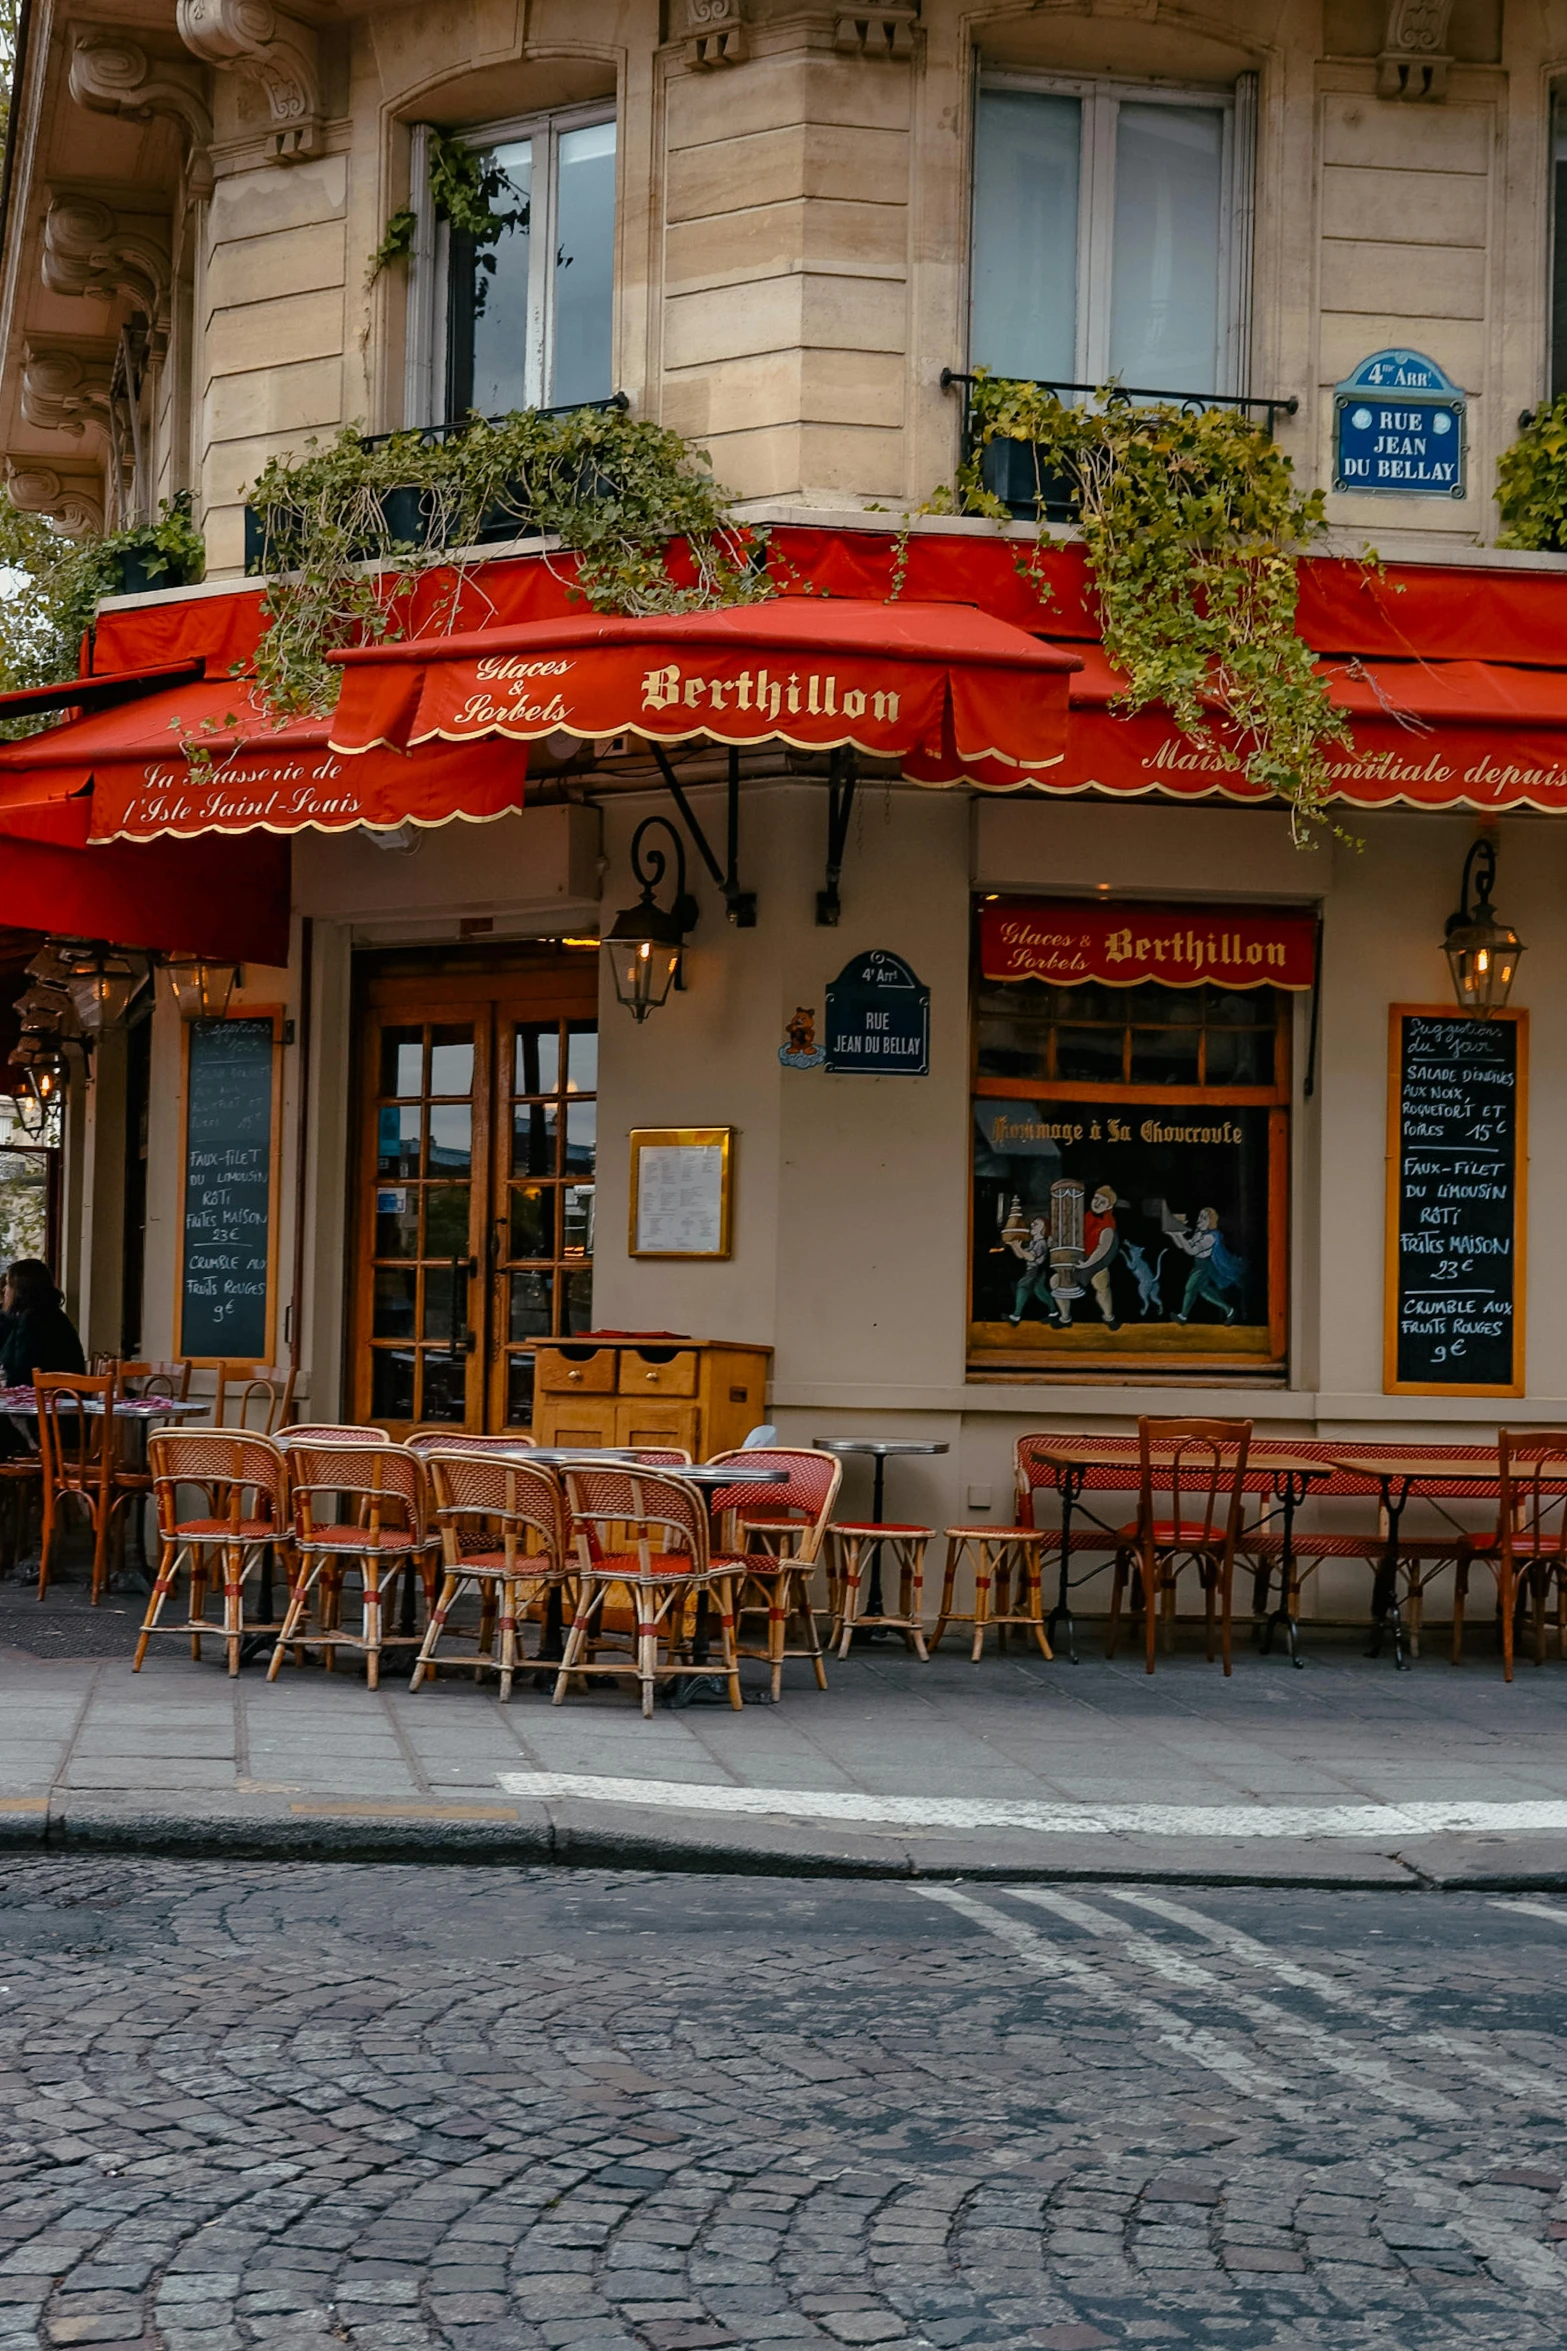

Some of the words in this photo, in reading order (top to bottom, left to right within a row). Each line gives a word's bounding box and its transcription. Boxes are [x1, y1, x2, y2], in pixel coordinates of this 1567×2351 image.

[1379, 411, 1423, 431] RUE
[1373, 436, 1427, 456] JEAN
[1344, 458, 1371, 476] DU
[1377, 460, 1456, 481] BELLAY
[476, 655, 577, 681] Glaces
[508, 679, 525, 695] &
[640, 664, 901, 724] Berthillon
[453, 693, 576, 723] Sorbets
[141, 762, 174, 789] La
[311, 754, 343, 780] de
[1141, 739, 1252, 774] Maiso
[1311, 751, 1458, 783] amiliale
[1463, 753, 1567, 797] depuis
[121, 795, 192, 824] l'Isle
[199, 787, 364, 818] Saint-Louis
[1000, 922, 1077, 947] Glaces
[1079, 934, 1091, 948] &
[1104, 927, 1287, 971] Berthillon
[1007, 948, 1093, 971] Sorbets
[866, 1012, 890, 1030] RUE
[1409, 1018, 1503, 1043] Suggestions
[833, 1035, 862, 1053] JEAN
[865, 1036, 880, 1053] DU
[883, 1036, 921, 1056] BELLAY
[1407, 1037, 1435, 1053] du
[1407, 1065, 1458, 1083] SALADE
[1403, 1083, 1427, 1098] AUX
[1482, 1105, 1506, 1118] ET
[1089, 1119, 1102, 1141] à
[1403, 1120, 1445, 1137] POIRES
[189, 1174, 205, 1186] DU
[1405, 1184, 1427, 1198] DU
[223, 1208, 268, 1225] MAISON
[1400, 1230, 1446, 1254] FRITES
[1449, 1235, 1510, 1255] MAISON
[189, 1254, 239, 1270] CRUMBLE
[1430, 1259, 1474, 1280] 23€
[186, 1276, 219, 1296] FRUITS
[223, 1279, 265, 1296] ROUGES
[1403, 1299, 1476, 1315] CRUMBLE
[1482, 1300, 1513, 1315] AUX
[1401, 1317, 1447, 1334] FRUITS
[1452, 1318, 1504, 1337] ROUGES
